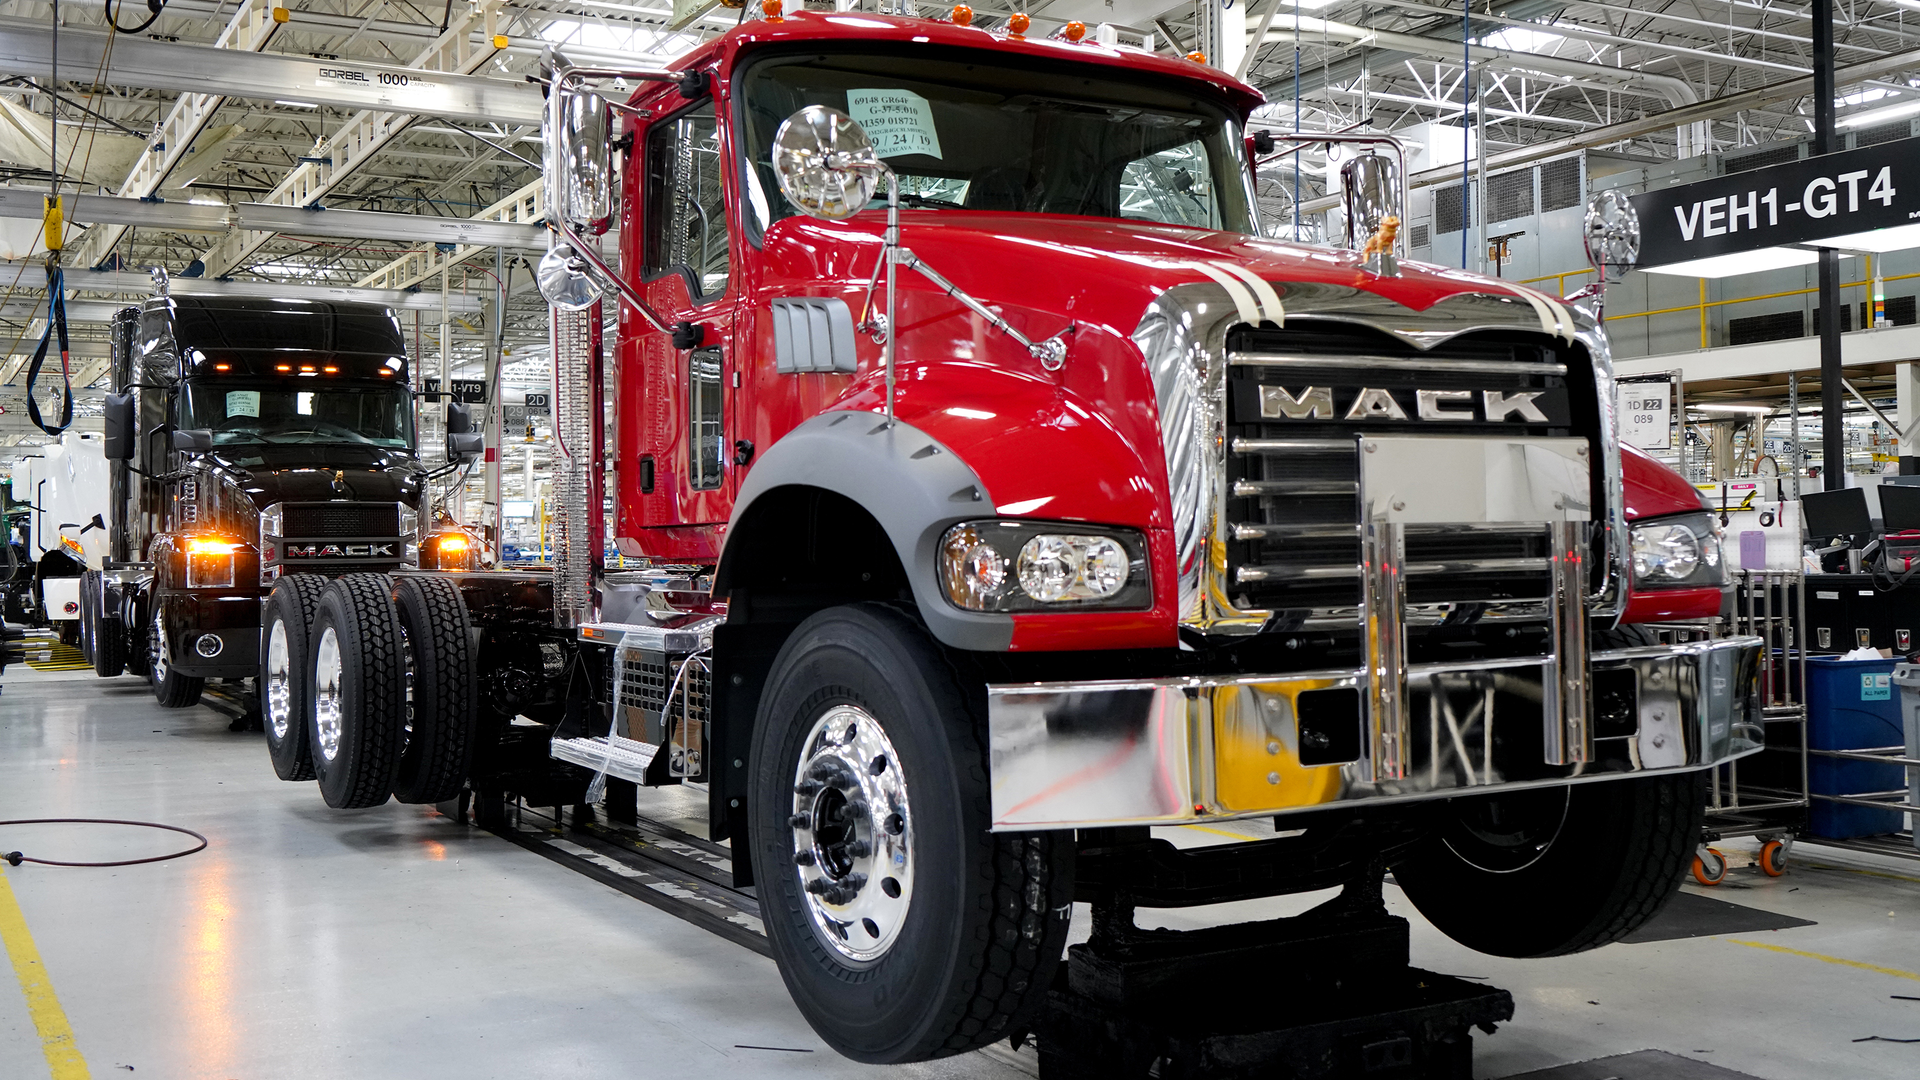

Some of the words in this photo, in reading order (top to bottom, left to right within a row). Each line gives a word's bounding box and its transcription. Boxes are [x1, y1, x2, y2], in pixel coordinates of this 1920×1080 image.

[1117, 39, 1142, 47] MACK
[319, 68, 370, 82] GORBEL
[377, 72, 408, 86] 1000
[854, 96, 879, 105] 69148
[887, 117, 918, 126] 018721
[870, 137, 879, 148] 9
[892, 133, 907, 145] 24
[919, 135, 931, 146] 19
[889, 145, 912, 153] EXCAVA
[1674, 165, 1896, 242] VEH1-GT4
[429, 382, 482, 393] VE1-VT9
[528, 394, 545, 406] 2D
[1258, 384, 1549, 422] MACK
[1627, 400, 1641, 410] 1D
[1646, 400, 1660, 410] 22
[508, 406, 524, 417] 29
[528, 407, 542, 415] 061
[1634, 414, 1653, 424] 089
[287, 543, 394, 557] MACK
